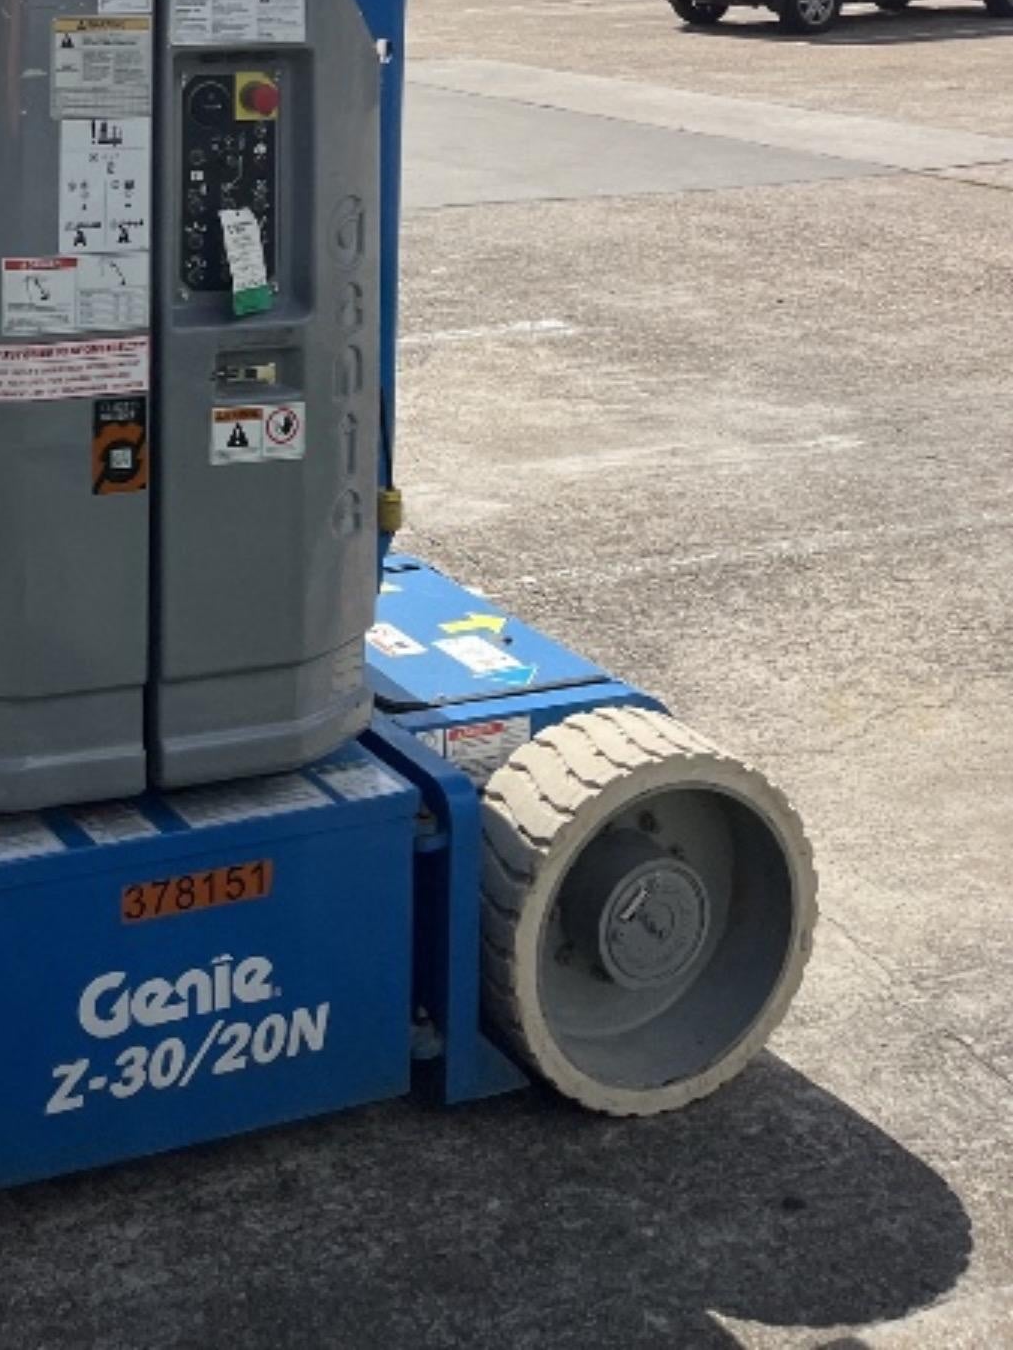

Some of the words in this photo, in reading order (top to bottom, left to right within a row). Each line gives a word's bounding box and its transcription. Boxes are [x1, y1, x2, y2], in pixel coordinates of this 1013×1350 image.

[123, 861, 270, 920] 378151
[78, 953, 274, 1039] Genie
[44, 1002, 331, 1116] Z-30/20N
